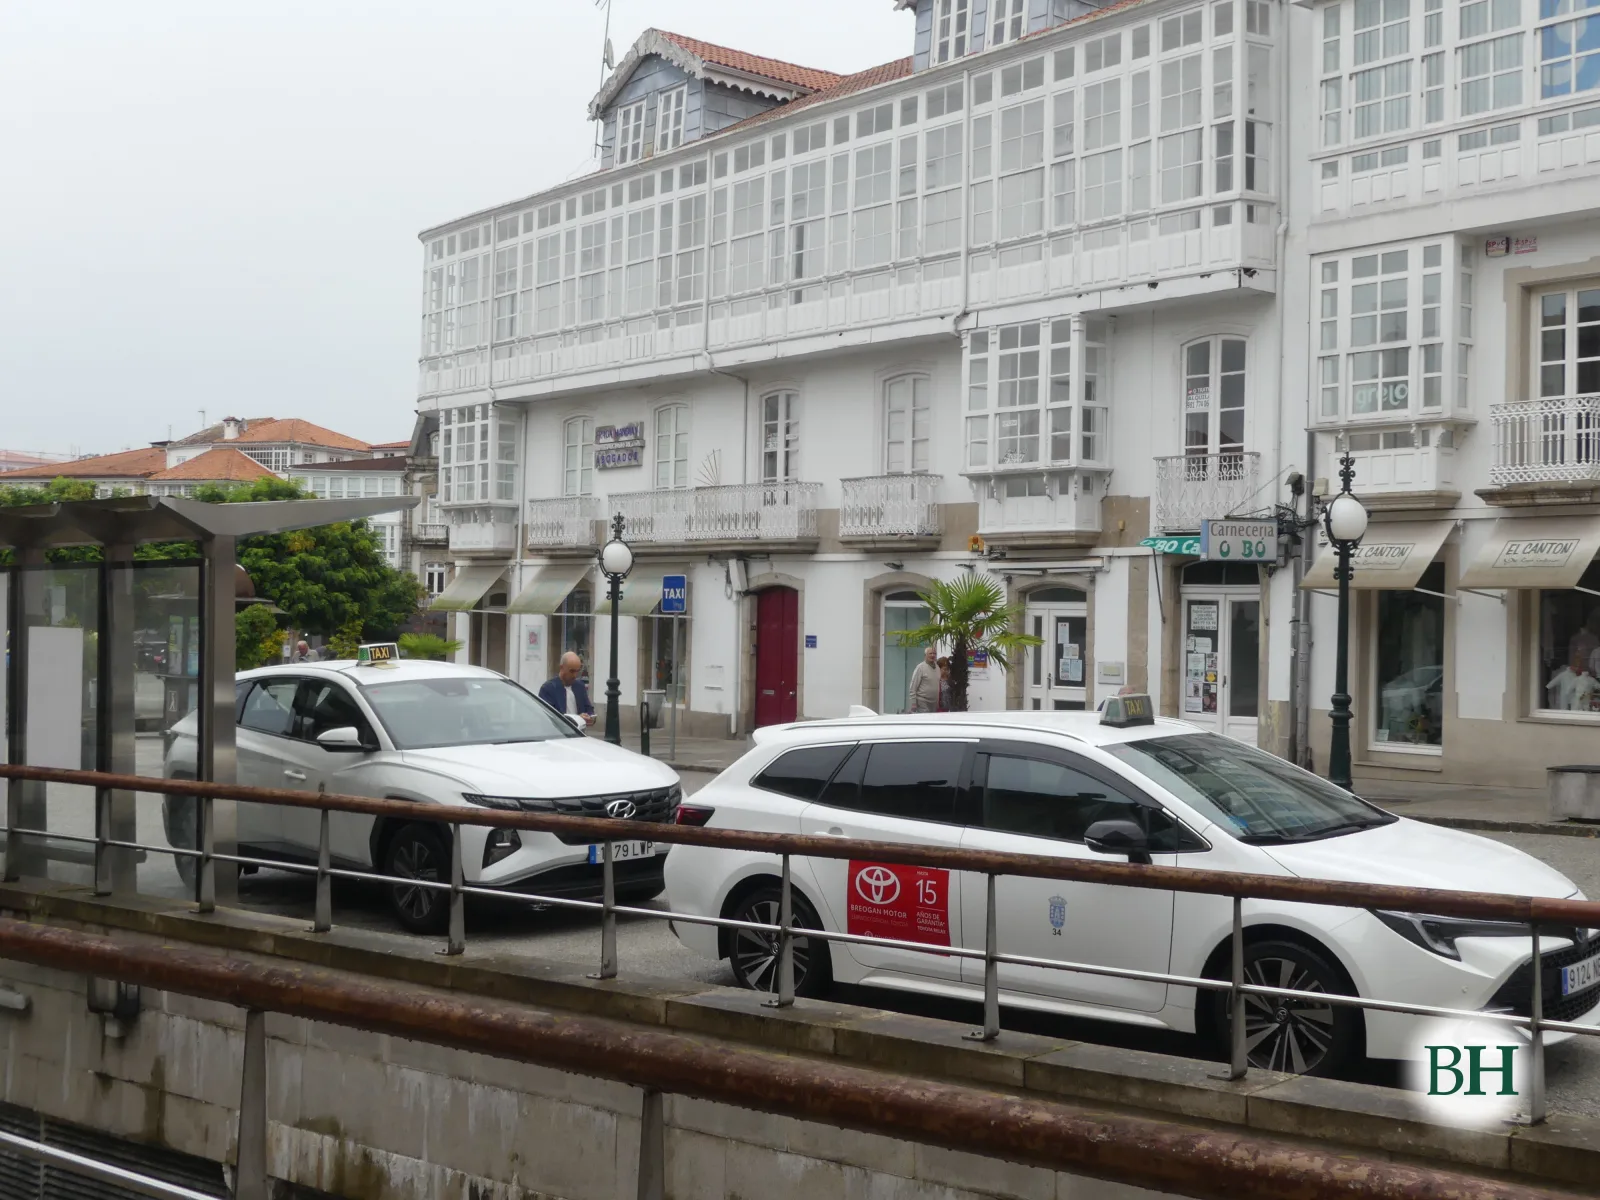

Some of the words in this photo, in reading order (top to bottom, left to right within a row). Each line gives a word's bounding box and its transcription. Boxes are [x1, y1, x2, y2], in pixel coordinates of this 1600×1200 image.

[596, 451, 638, 464] ABOGADOS
[1365, 546, 1409, 558] CANTON
[1505, 543, 1520, 555] EL
[1522, 542, 1573, 555] CANTON
[663, 588, 685, 599] TAXI
[370, 646, 390, 660] TAXI
[1125, 700, 1144, 715] TAXI
[601, 844, 629, 860] 179
[916, 879, 937, 905] 15
[850, 904, 882, 914] BREOGAN
[883, 909, 908, 918] MOTOR
[1052, 927, 1062, 936] 34
[1569, 961, 1591, 989] 9124
